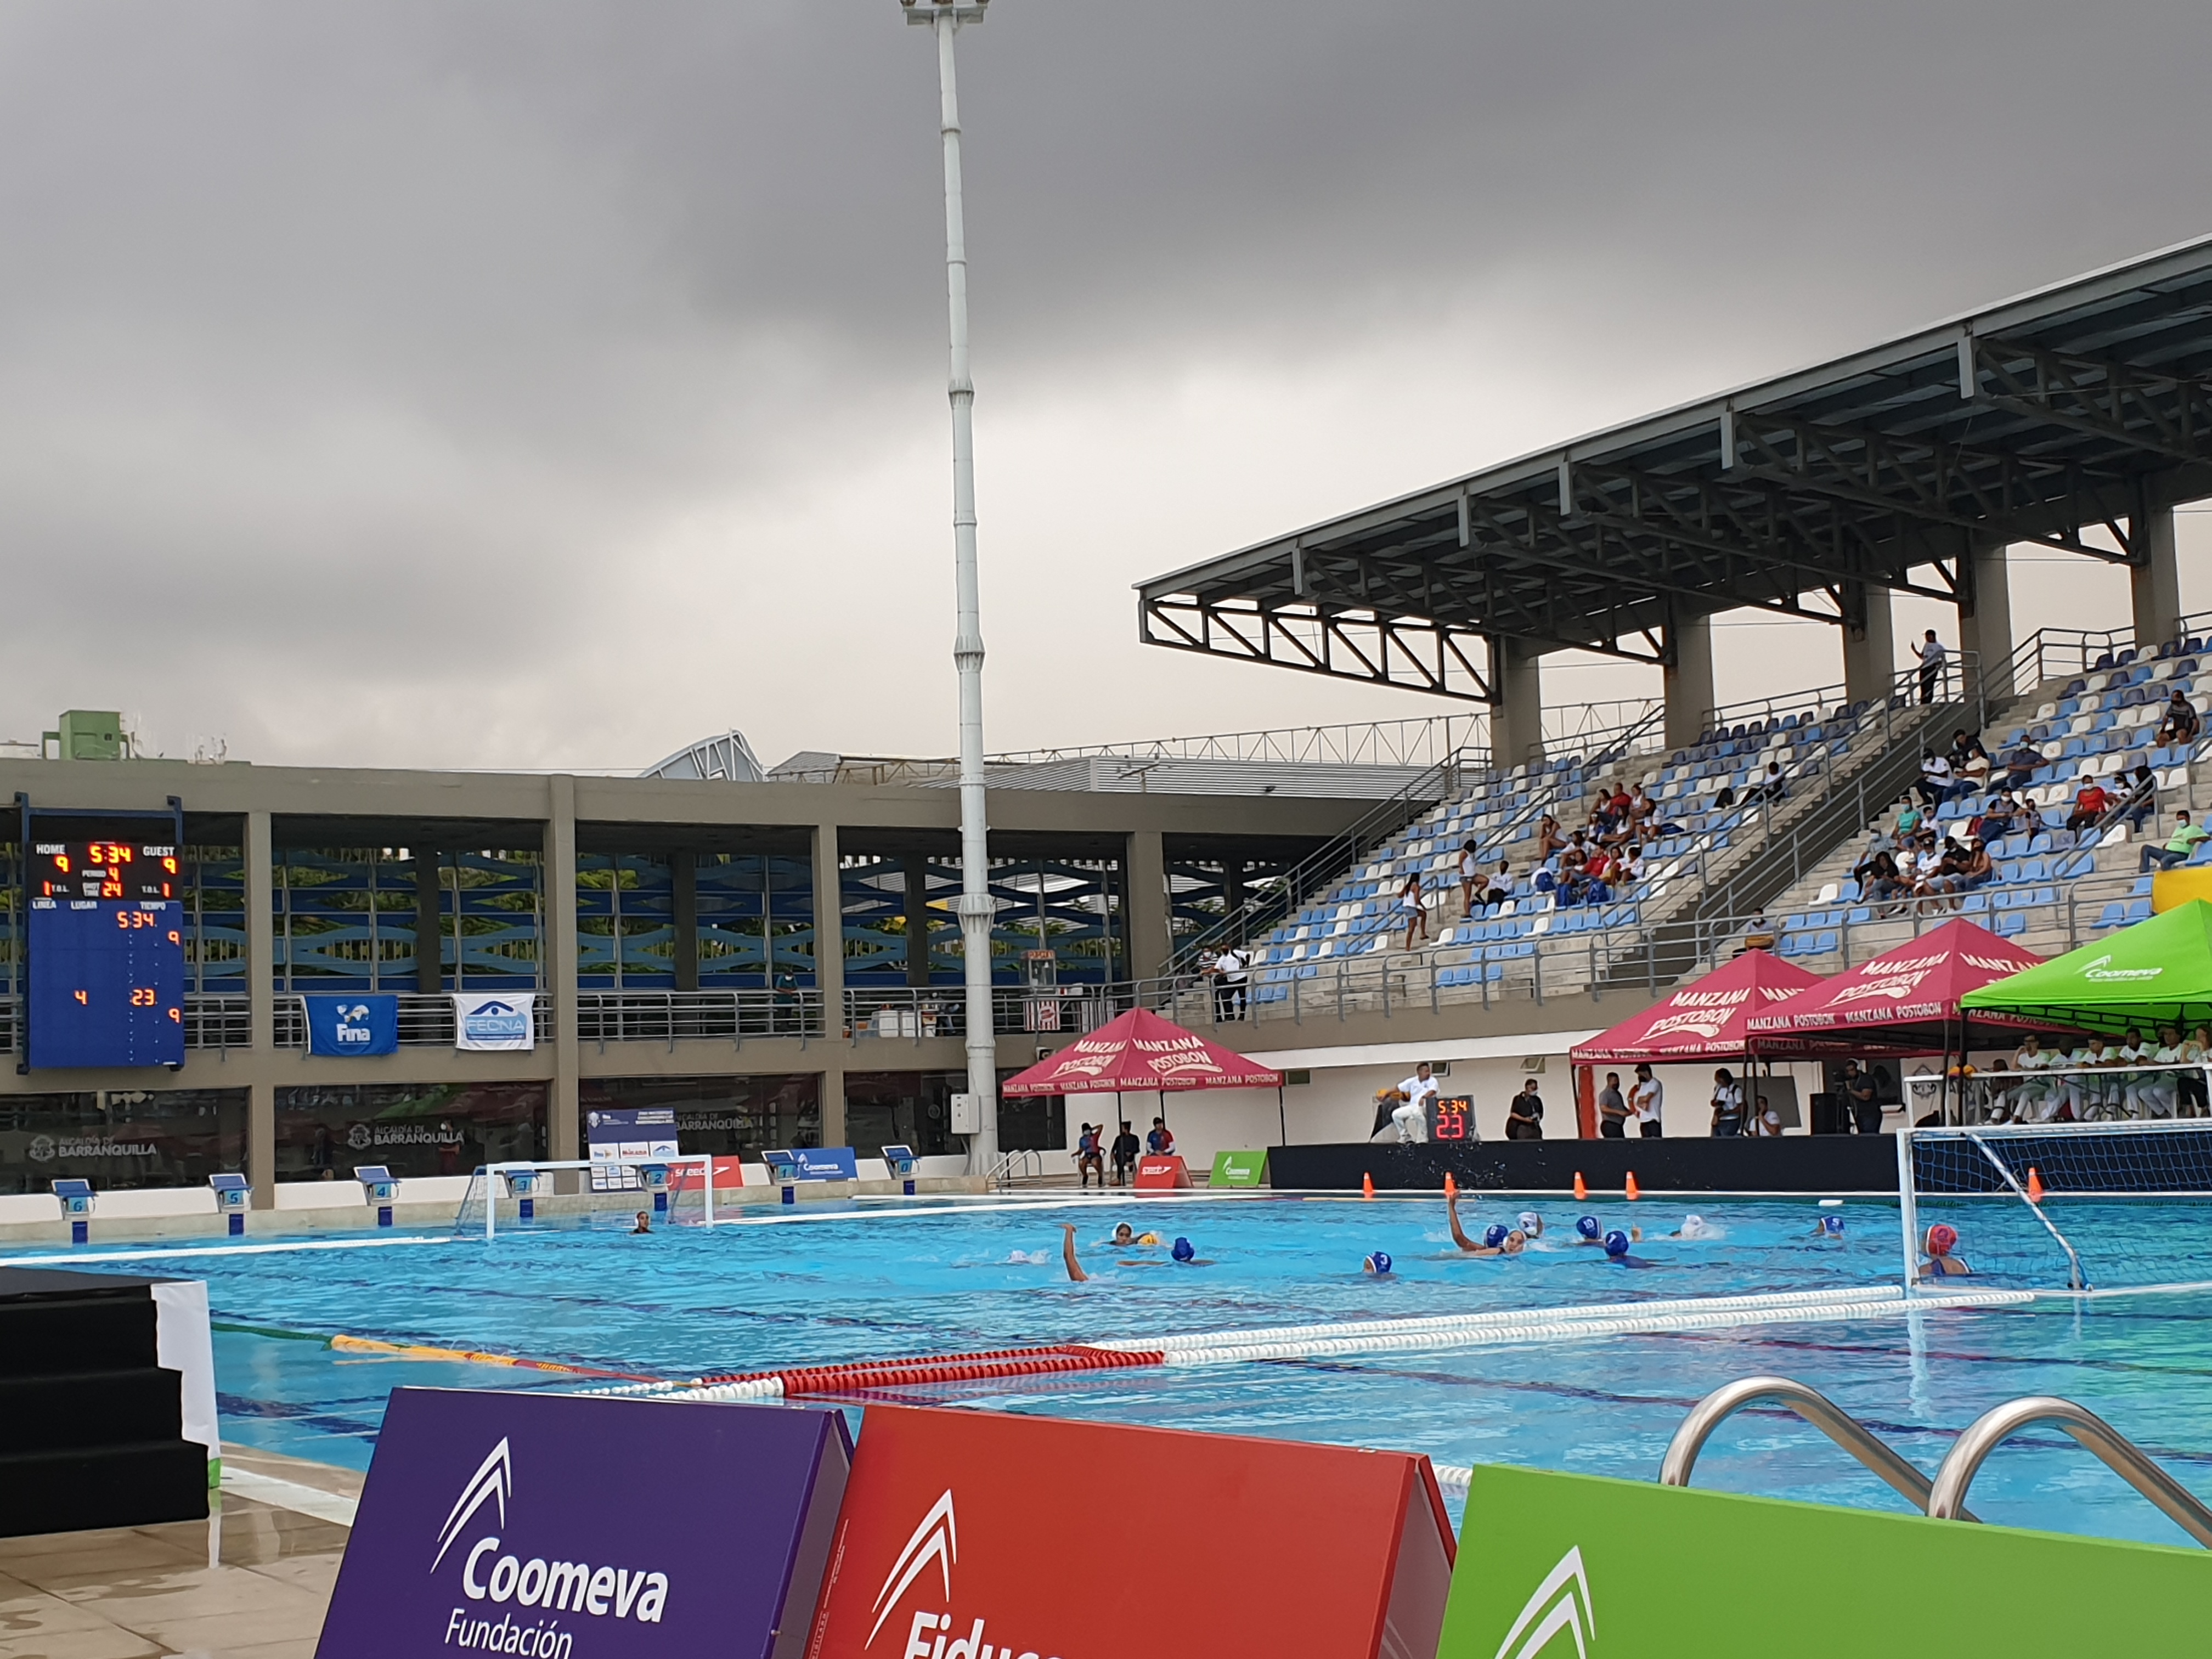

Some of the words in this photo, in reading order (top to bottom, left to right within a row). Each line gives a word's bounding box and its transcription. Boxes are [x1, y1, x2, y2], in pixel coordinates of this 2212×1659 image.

[36, 844, 65, 854] HOME
[89, 845, 132, 863] 5:34
[143, 847, 175, 856] GUEST
[55, 856, 69, 872] 9
[163, 857, 177, 874] 9
[109, 867, 119, 881] 4
[43, 881, 51, 896] 1
[103, 882, 122, 897] 24
[163, 883, 171, 898] 1
[71, 901, 97, 910] LUGAR
[140, 901, 166, 911] TIEMPO
[168, 931, 180, 946] 9
[1859, 951, 1950, 975] MANZANA
[1960, 952, 2040, 973] MANZA
[1831, 969, 1932, 1003] POSTOBON
[75, 990, 88, 1005] 4
[132, 989, 155, 1006] 23
[1669, 987, 1751, 1006] MANZANA
[168, 1008, 180, 1024] 9
[1645, 1007, 1736, 1036] POSTOBON
[1747, 1016, 1791, 1030] MANZANA
[1793, 1013, 1835, 1027] POSTOBON
[1844, 1007, 1893, 1023] MANZANA
[1896, 1002, 1942, 1018] POSTOBON
[467, 1019, 524, 1031] FECNA
[1132, 1036, 1205, 1052] MANZANA
[1147, 1051, 1213, 1074] POSTOBON
[1120, 1077, 1158, 1087] MANZANA
[1205, 1074, 1242, 1085] MANZANA
[1245, 1074, 1278, 1083] POSTOBON
[1438, 1100, 1468, 1114] 5:34
[1436, 1114, 1463, 1138] 23
[374, 1131, 465, 1146] BARRANQUILLA
[59, 1144, 157, 1158] BARRANQUILLA
[653, 1173, 662, 1184] 2
[229, 1193, 239, 1204] 5
[377, 1186, 386, 1198] 4
[73, 1200, 83, 1212] 6
[1380, 1254, 1387, 1265] 3
[462, 1536, 669, 1623] Coomeva
[444, 1607, 573, 1659] Fundación
